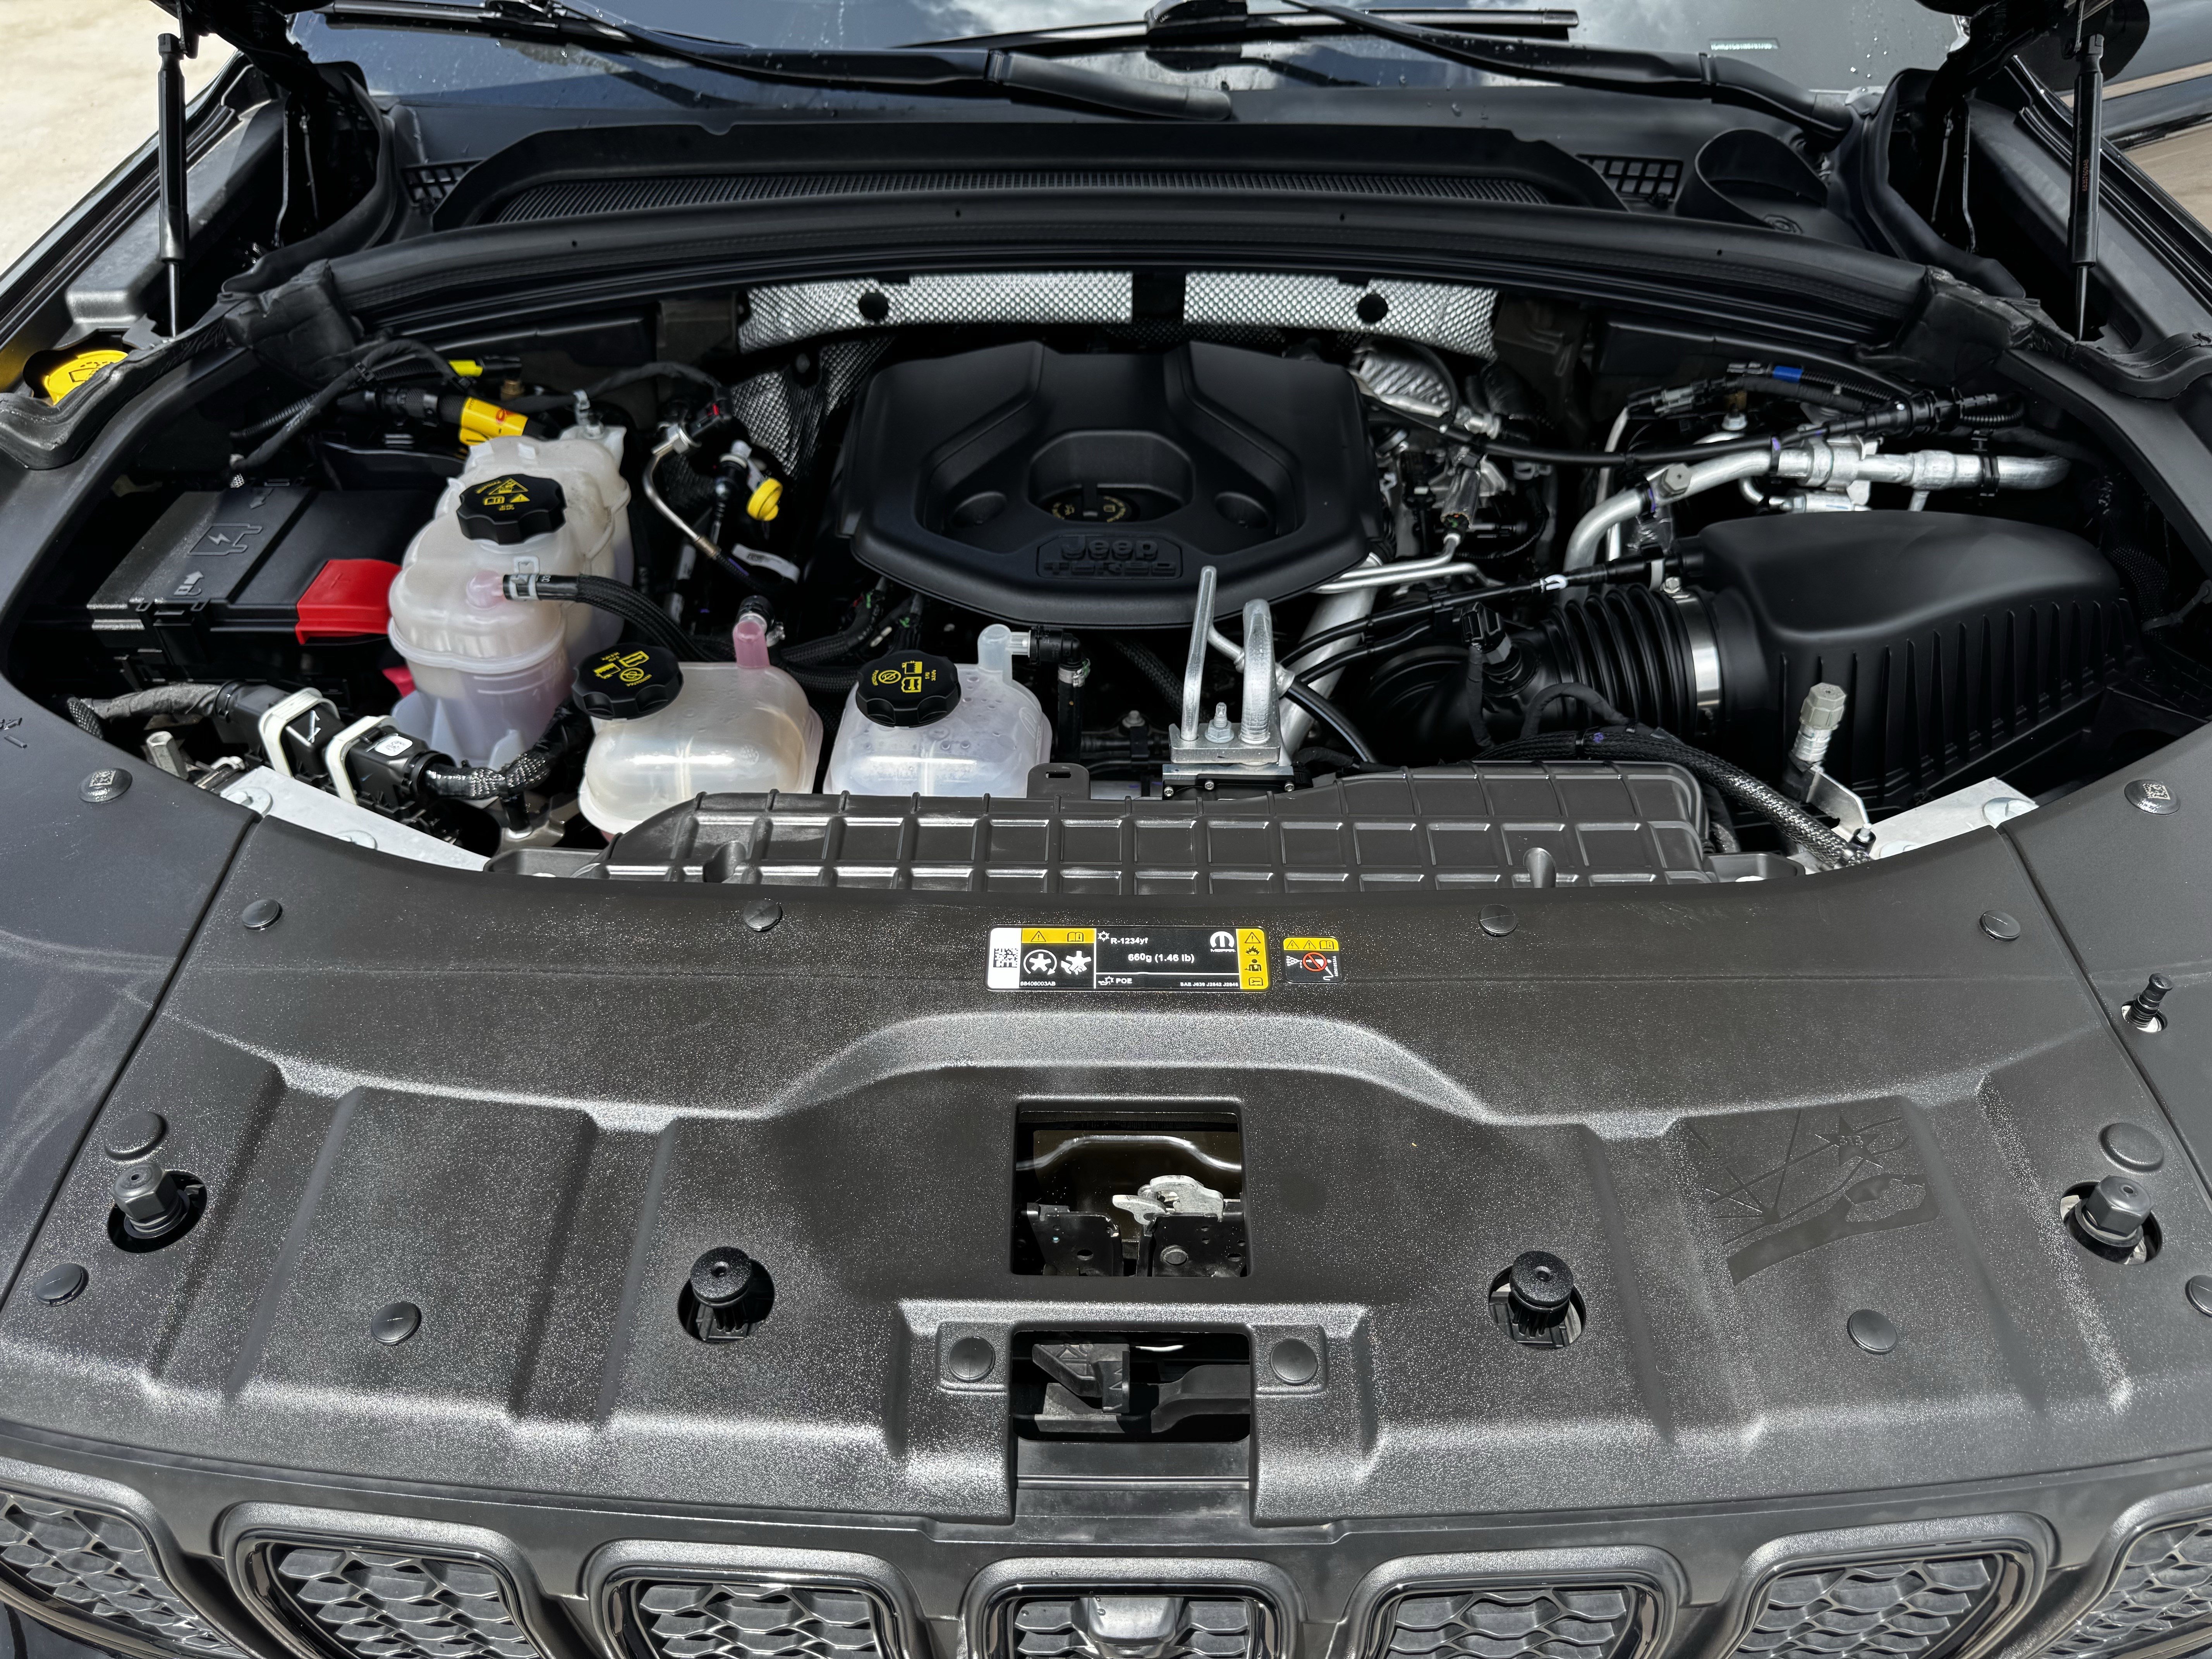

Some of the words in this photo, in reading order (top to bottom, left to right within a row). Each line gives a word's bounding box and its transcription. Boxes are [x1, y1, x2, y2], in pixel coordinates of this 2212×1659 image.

[1061, 536, 1158, 560] Jeep
[1128, 953, 1152, 962] 660g
[1154, 953, 1179, 963] (1.46
[1182, 953, 1195, 963] lb)
